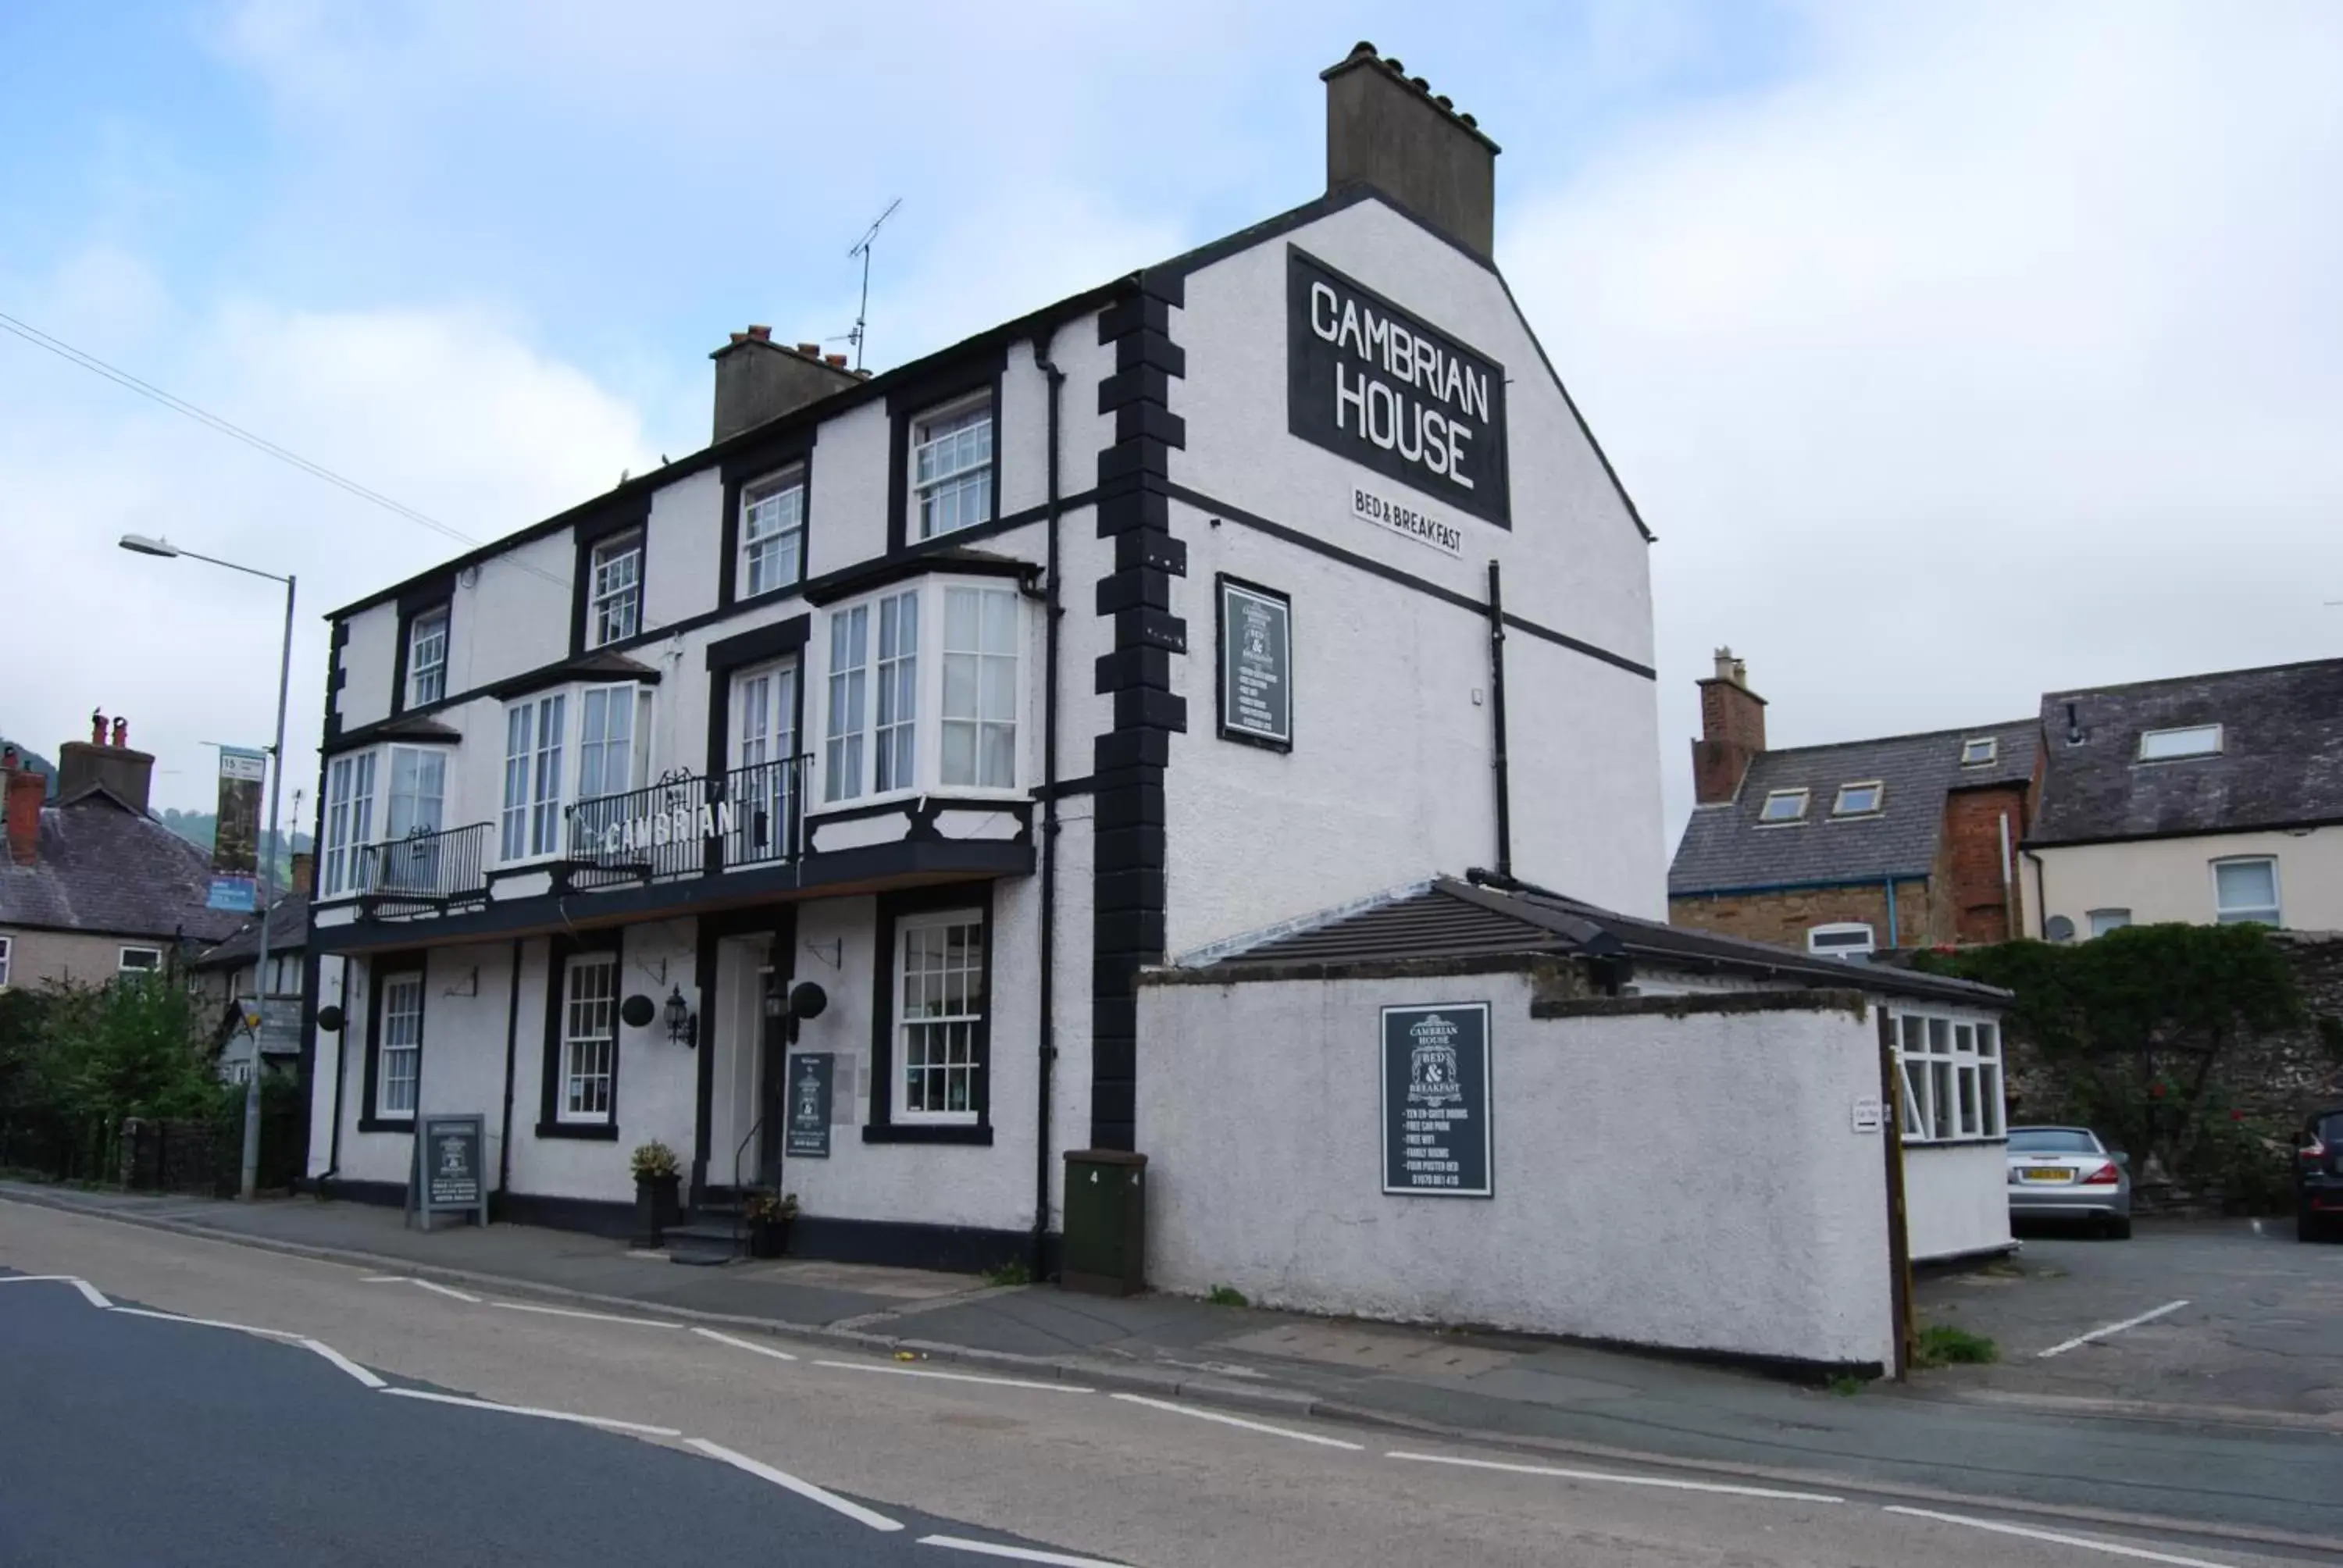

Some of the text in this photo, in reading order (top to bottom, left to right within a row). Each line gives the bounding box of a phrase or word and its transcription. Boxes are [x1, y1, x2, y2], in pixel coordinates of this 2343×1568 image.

[1311, 281, 1489, 424] CAMBRIAN
[1336, 362, 1475, 489] HOUSE
[1355, 489, 1461, 553] BED & BREAKFAST
[604, 800, 735, 854] CAMBRIAN
[1422, 1052, 1446, 1063] BED
[1425, 1063, 1443, 1082] &
